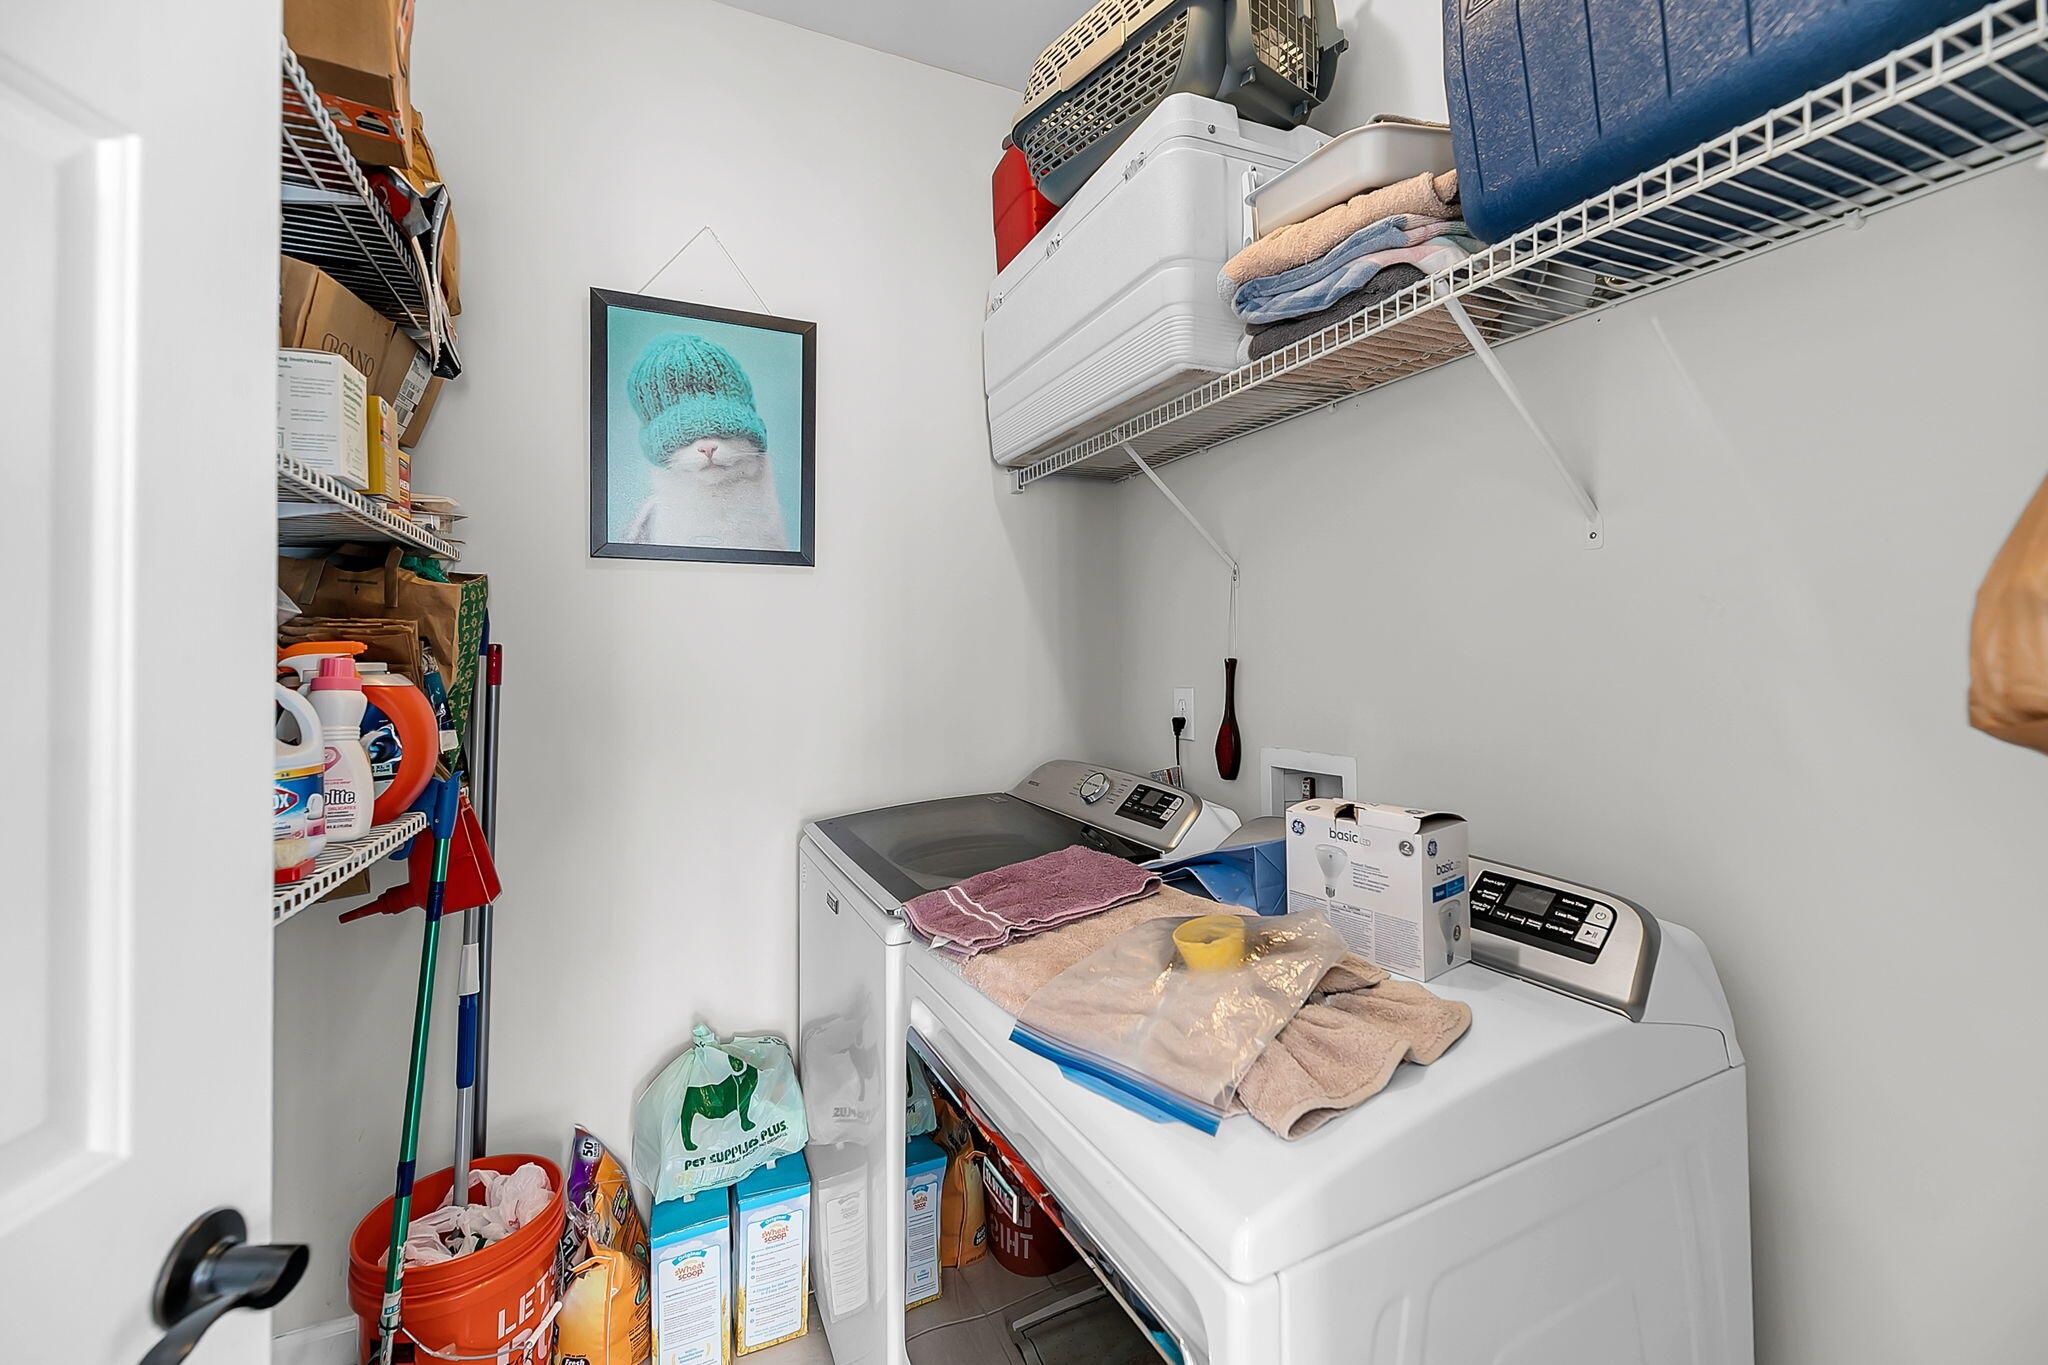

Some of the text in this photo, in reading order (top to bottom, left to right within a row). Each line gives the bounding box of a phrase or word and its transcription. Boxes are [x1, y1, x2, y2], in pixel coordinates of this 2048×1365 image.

[1329, 827, 1359, 844] basic
[1436, 860, 1454, 876] basic
[684, 1156, 706, 1171] PET
[760, 1119, 788, 1140] PLUS
[764, 1232, 787, 1244] scoop
[674, 1261, 705, 1276] sWheat
[678, 1268, 703, 1281] scoop
